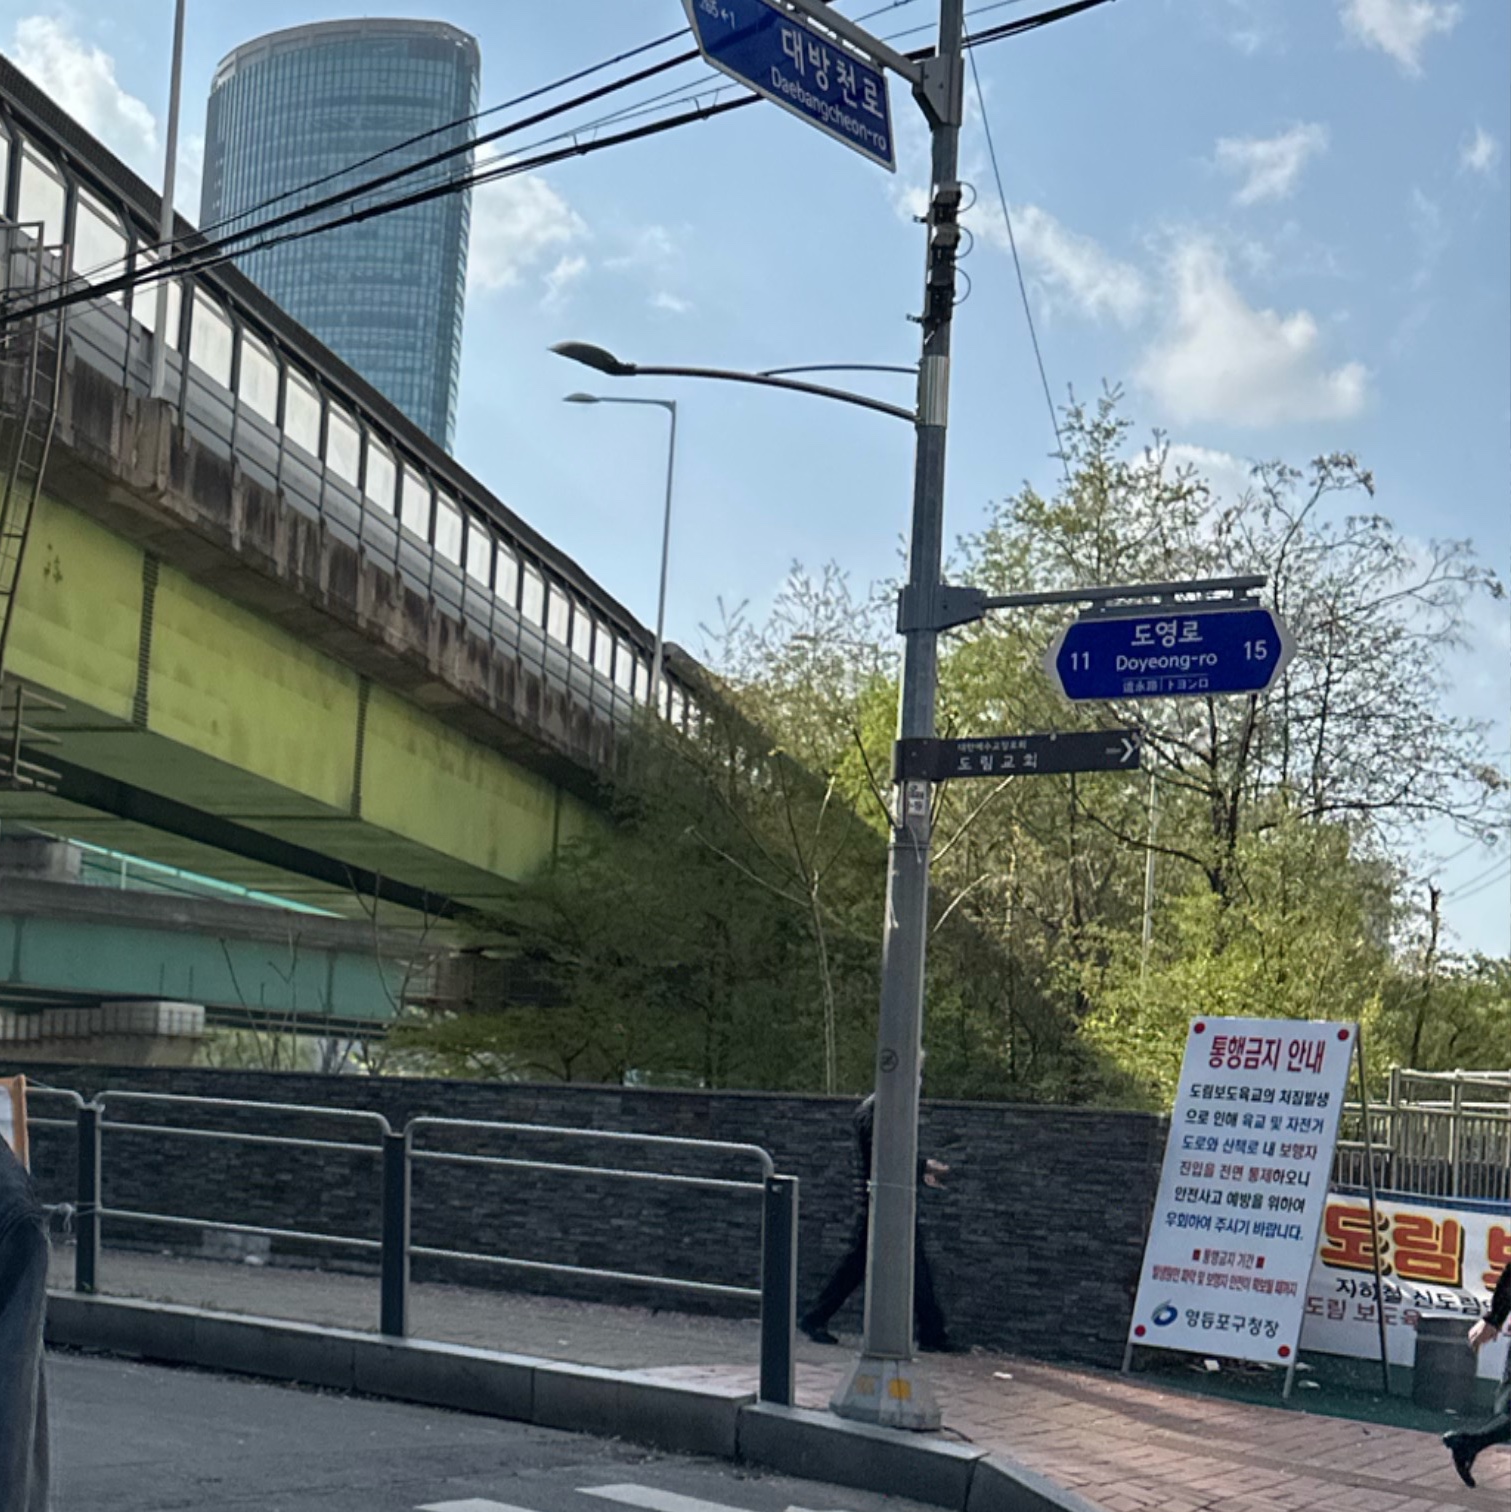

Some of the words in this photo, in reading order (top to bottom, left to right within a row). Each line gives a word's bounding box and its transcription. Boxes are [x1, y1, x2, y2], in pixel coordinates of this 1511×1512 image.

[781, 28, 884, 119] 대방천로
[771, 66, 887, 151] Daebangcheon-ro
[1131, 619, 1203, 648] 도영로
[1071, 652, 1090, 671] 11
[1116, 652, 1218, 673] Doyeong-ro
[1243, 640, 1268, 661] 15
[1209, 1035, 1282, 1071] 통행금지
[1287, 1039, 1326, 1074] 안내
[1189, 1083, 1276, 1103] 도림보도육교의
[1185, 1108, 1209, 1125] 으로
[1213, 1110, 1239, 1127] 인해
[1242, 1112, 1267, 1129] 육교
[1270, 1115, 1283, 1131] 및
[1286, 1116, 1325, 1134] 자전거
[1182, 1135, 1219, 1153] 도로와
[1222, 1137, 1260, 1154] 산책로
[1262, 1140, 1276, 1157] 내
[1279, 1142, 1318, 1160] 보행자
[1180, 1160, 1215, 1178] 진입을
[1219, 1163, 1244, 1181] 전면
[1248, 1166, 1311, 1187] 통제하오니
[1174, 1186, 1223, 1205] 안전사고
[1226, 1191, 1263, 1210] 예방을
[1268, 1195, 1306, 1214] 위하여
[1165, 1211, 1212, 1232] 우회하여
[1214, 1216, 1251, 1236] 주시기
[1252, 1221, 1304, 1241] 바랍니다.
[1319, 1204, 1464, 1288] 도림
[1305, 1296, 1346, 1320] 도림
[1185, 1308, 1280, 1339] 영등포구청장
